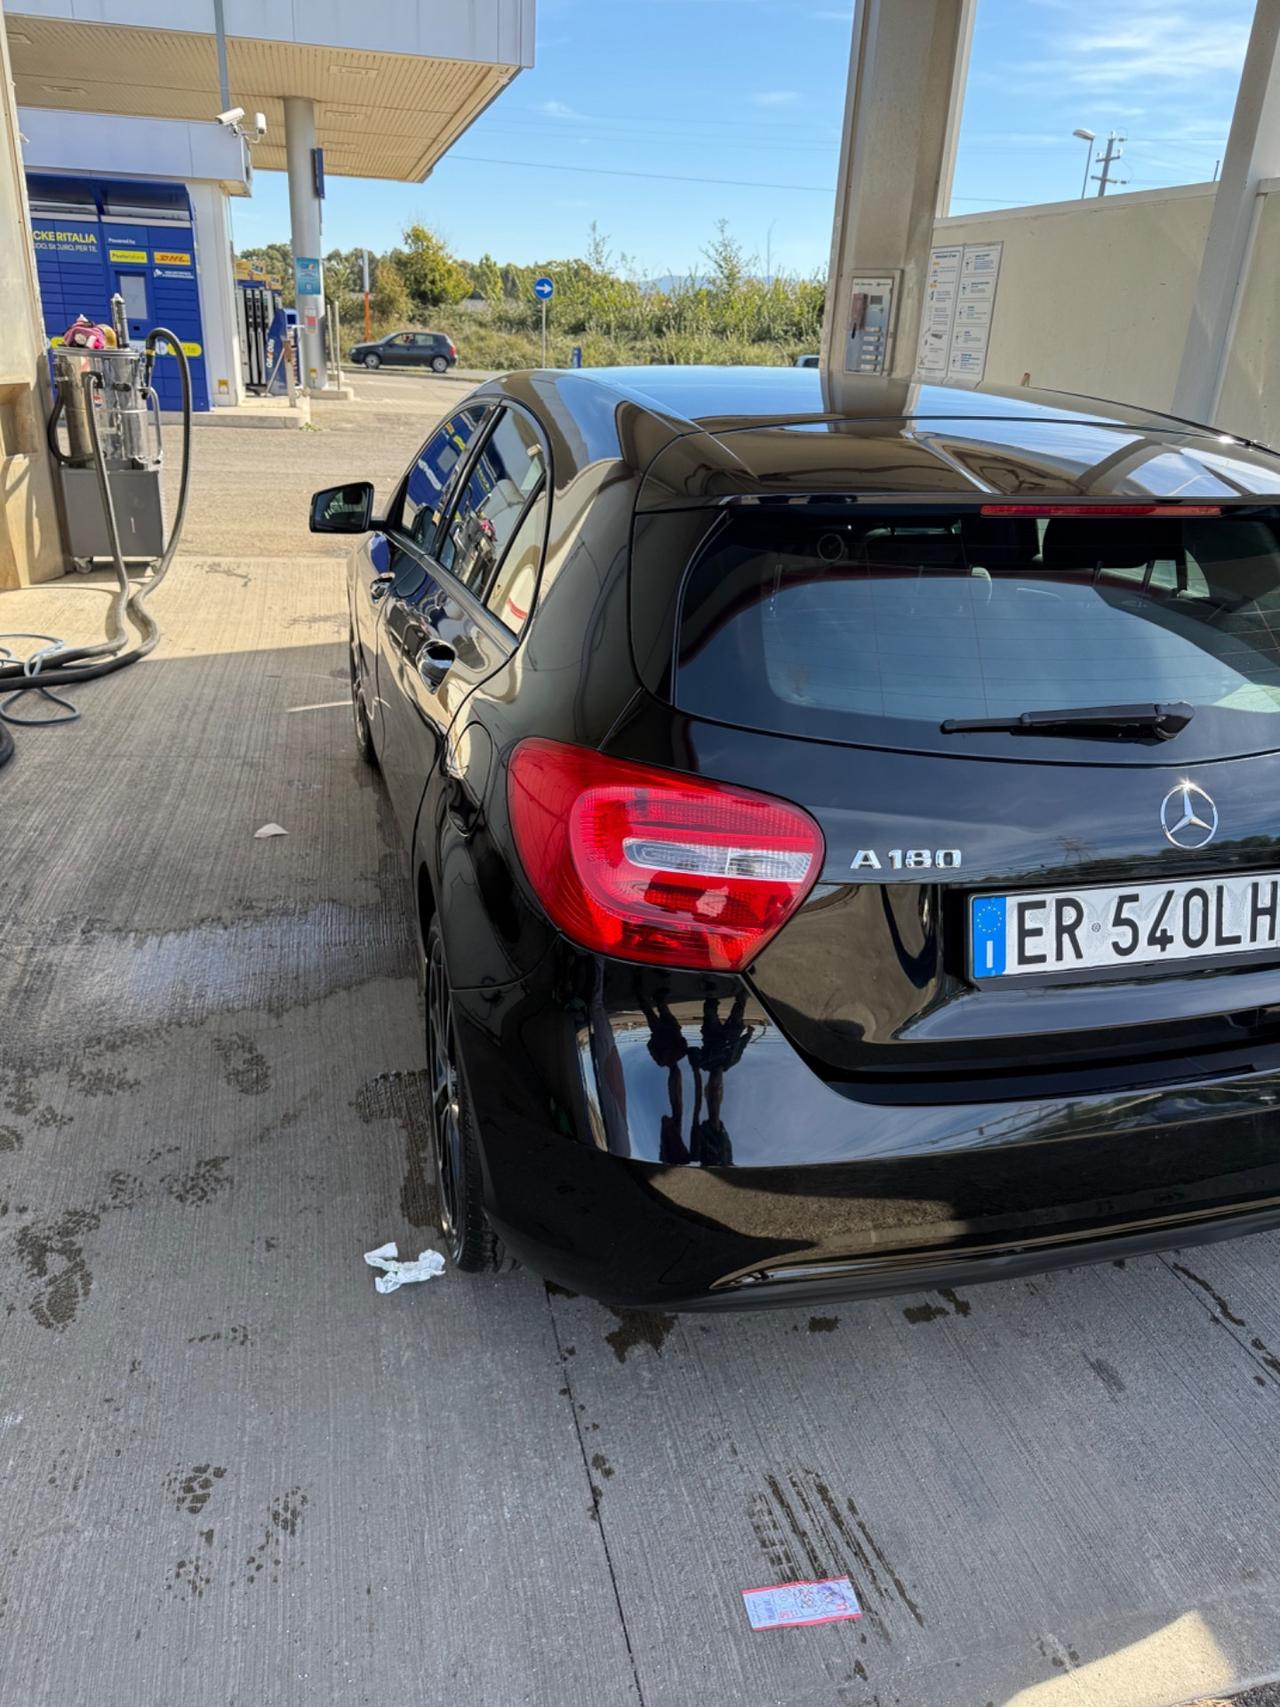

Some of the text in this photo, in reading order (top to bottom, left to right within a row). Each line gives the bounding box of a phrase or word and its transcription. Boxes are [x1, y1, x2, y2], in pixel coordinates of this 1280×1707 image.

[32, 230, 97, 244] CKERITALIA
[159, 255, 186, 263] DHL
[850, 849, 962, 869] A 180
[1017, 896, 1084, 966] ER
[1111, 880, 1279, 957] 540LH
